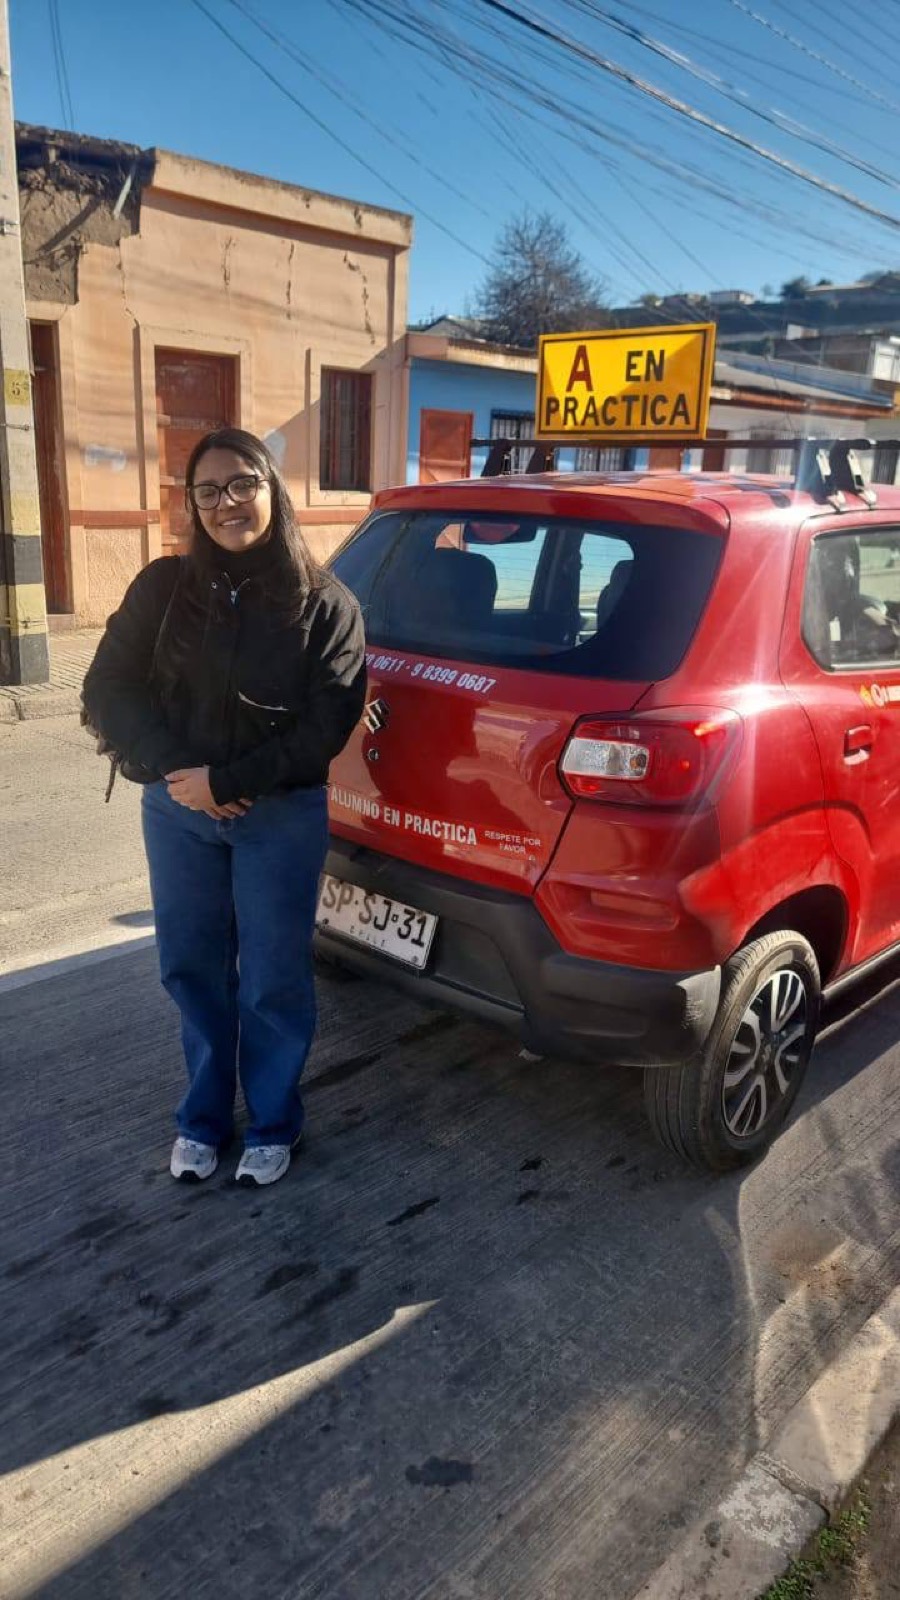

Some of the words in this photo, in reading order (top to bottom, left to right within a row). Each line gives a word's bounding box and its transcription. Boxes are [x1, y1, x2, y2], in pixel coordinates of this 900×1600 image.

[566, 344, 593, 392] A
[625, 349, 665, 382] EN
[545, 393, 691, 426] PRACTICA
[372, 655, 406, 672] 0611
[411, 663, 424, 677] 9
[422, 665, 458, 685] 8399
[456, 673, 497, 694] 0687
[330, 786, 380, 820] ALUMNO
[383, 806, 400, 827] EN
[404, 813, 477, 846] PRACTICA
[484, 830, 520, 844] RESPETE
[523, 836, 541, 847] POR
[500, 842, 526, 855] FAVOR
